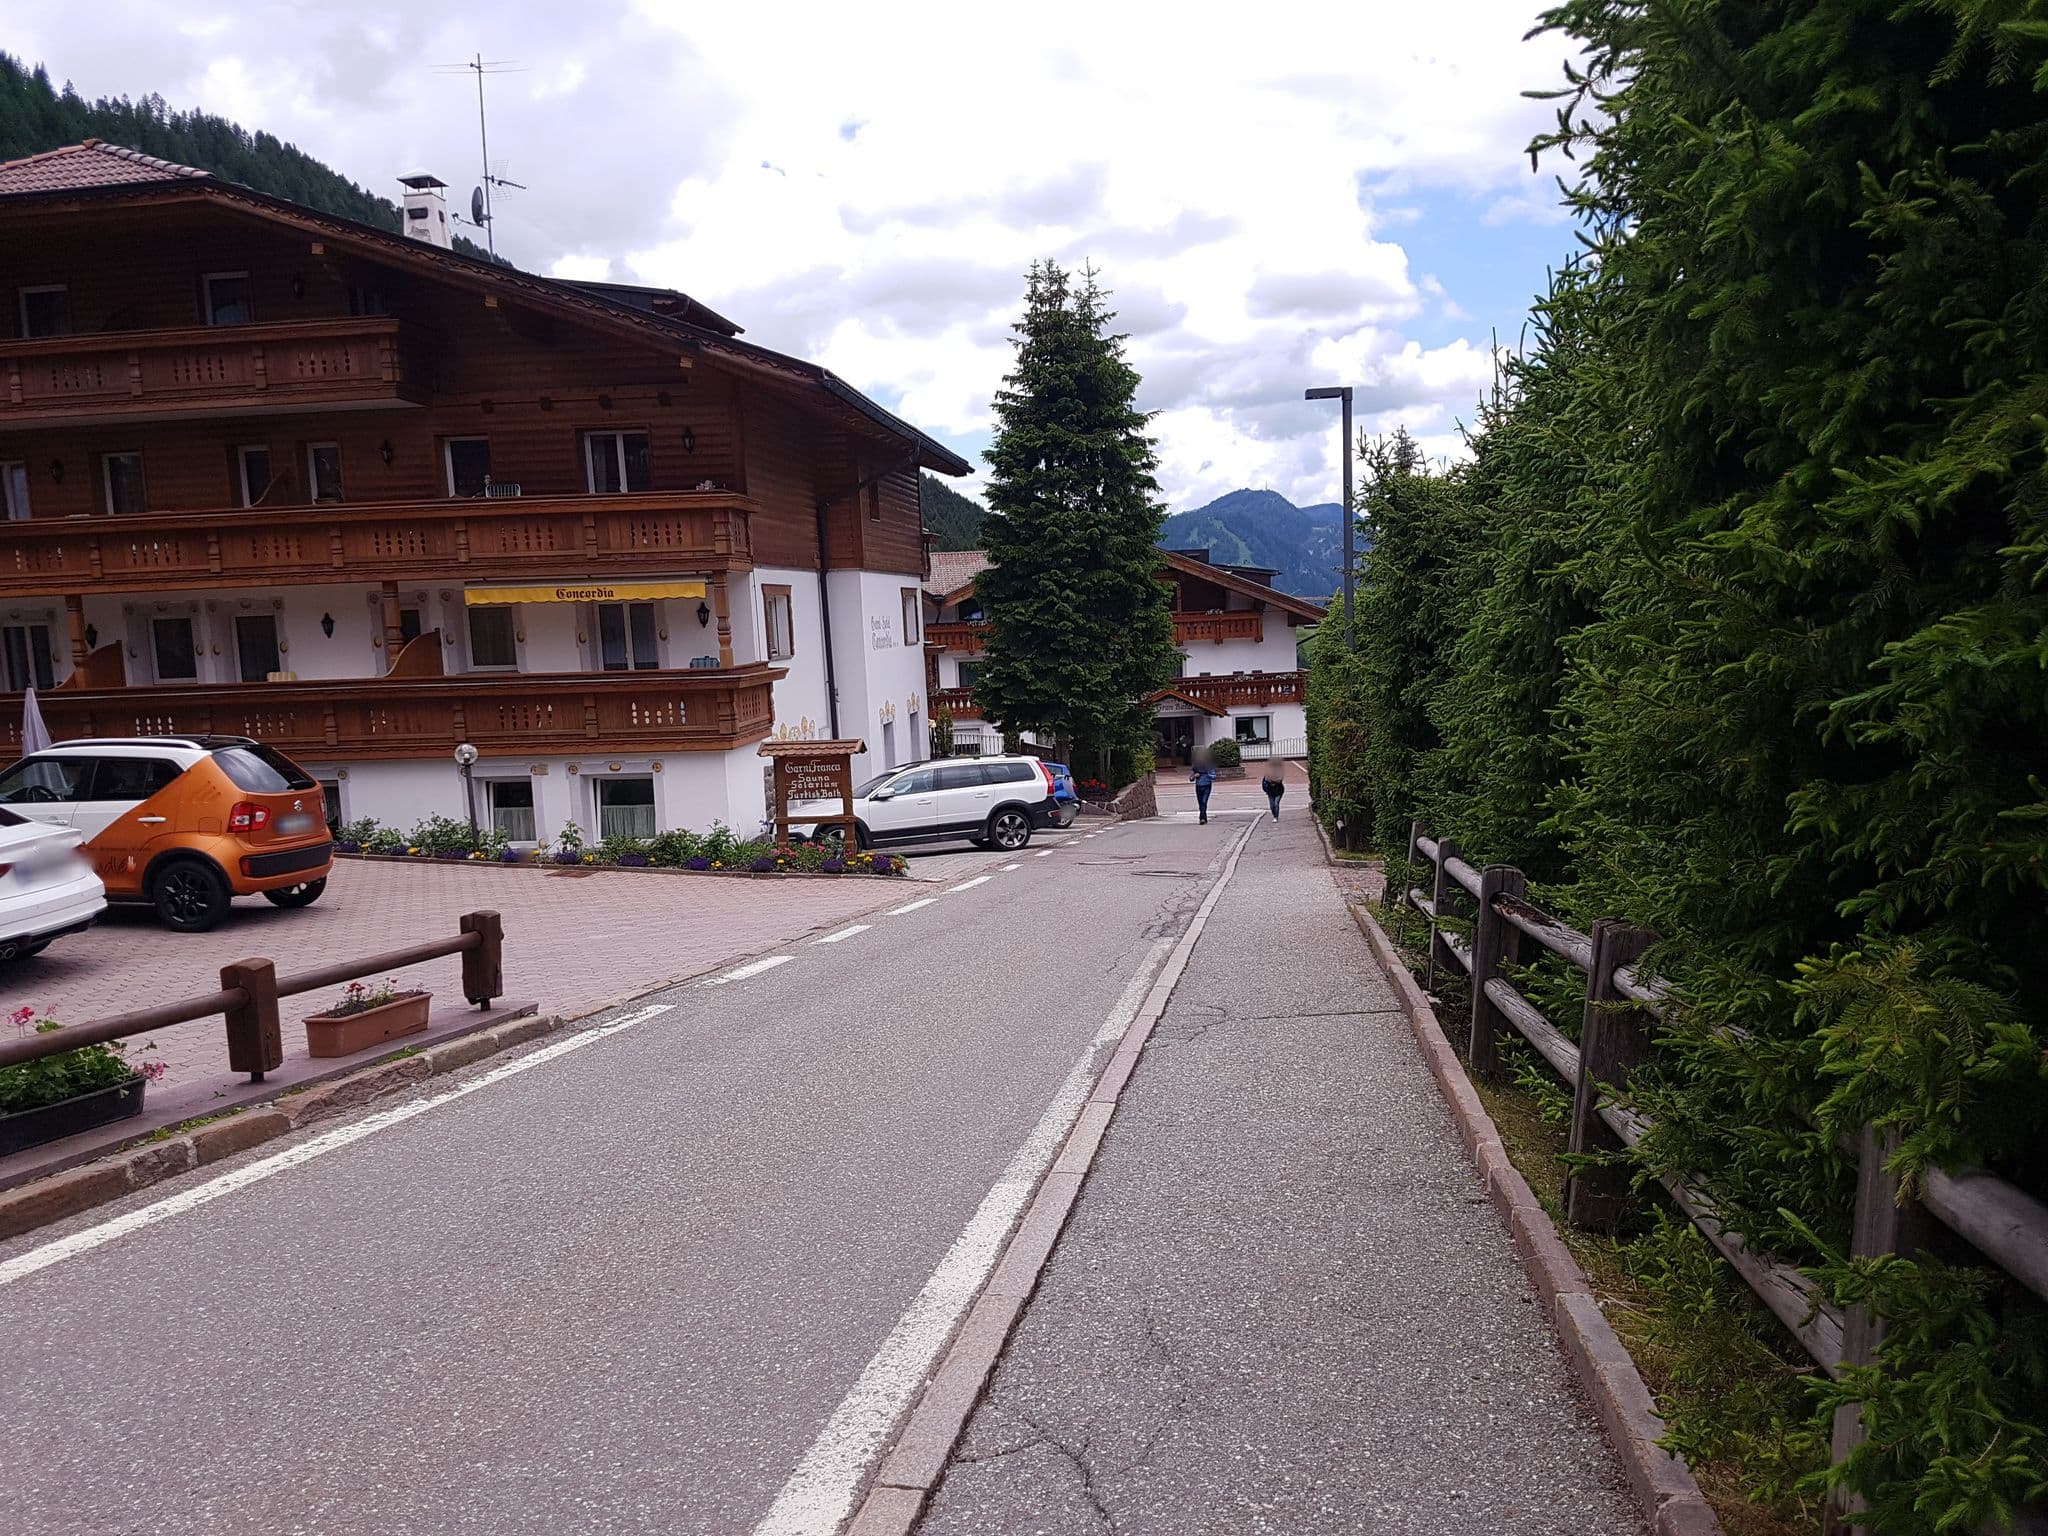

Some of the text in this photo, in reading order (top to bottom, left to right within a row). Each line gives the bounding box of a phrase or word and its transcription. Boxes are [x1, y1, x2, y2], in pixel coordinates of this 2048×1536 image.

[556, 588, 614, 599] Concordia
[785, 762, 811, 774] Garni
[798, 773, 830, 783] Sauna
[791, 780, 838, 790] Solarium
[788, 788, 842, 800] Turkish Bath
